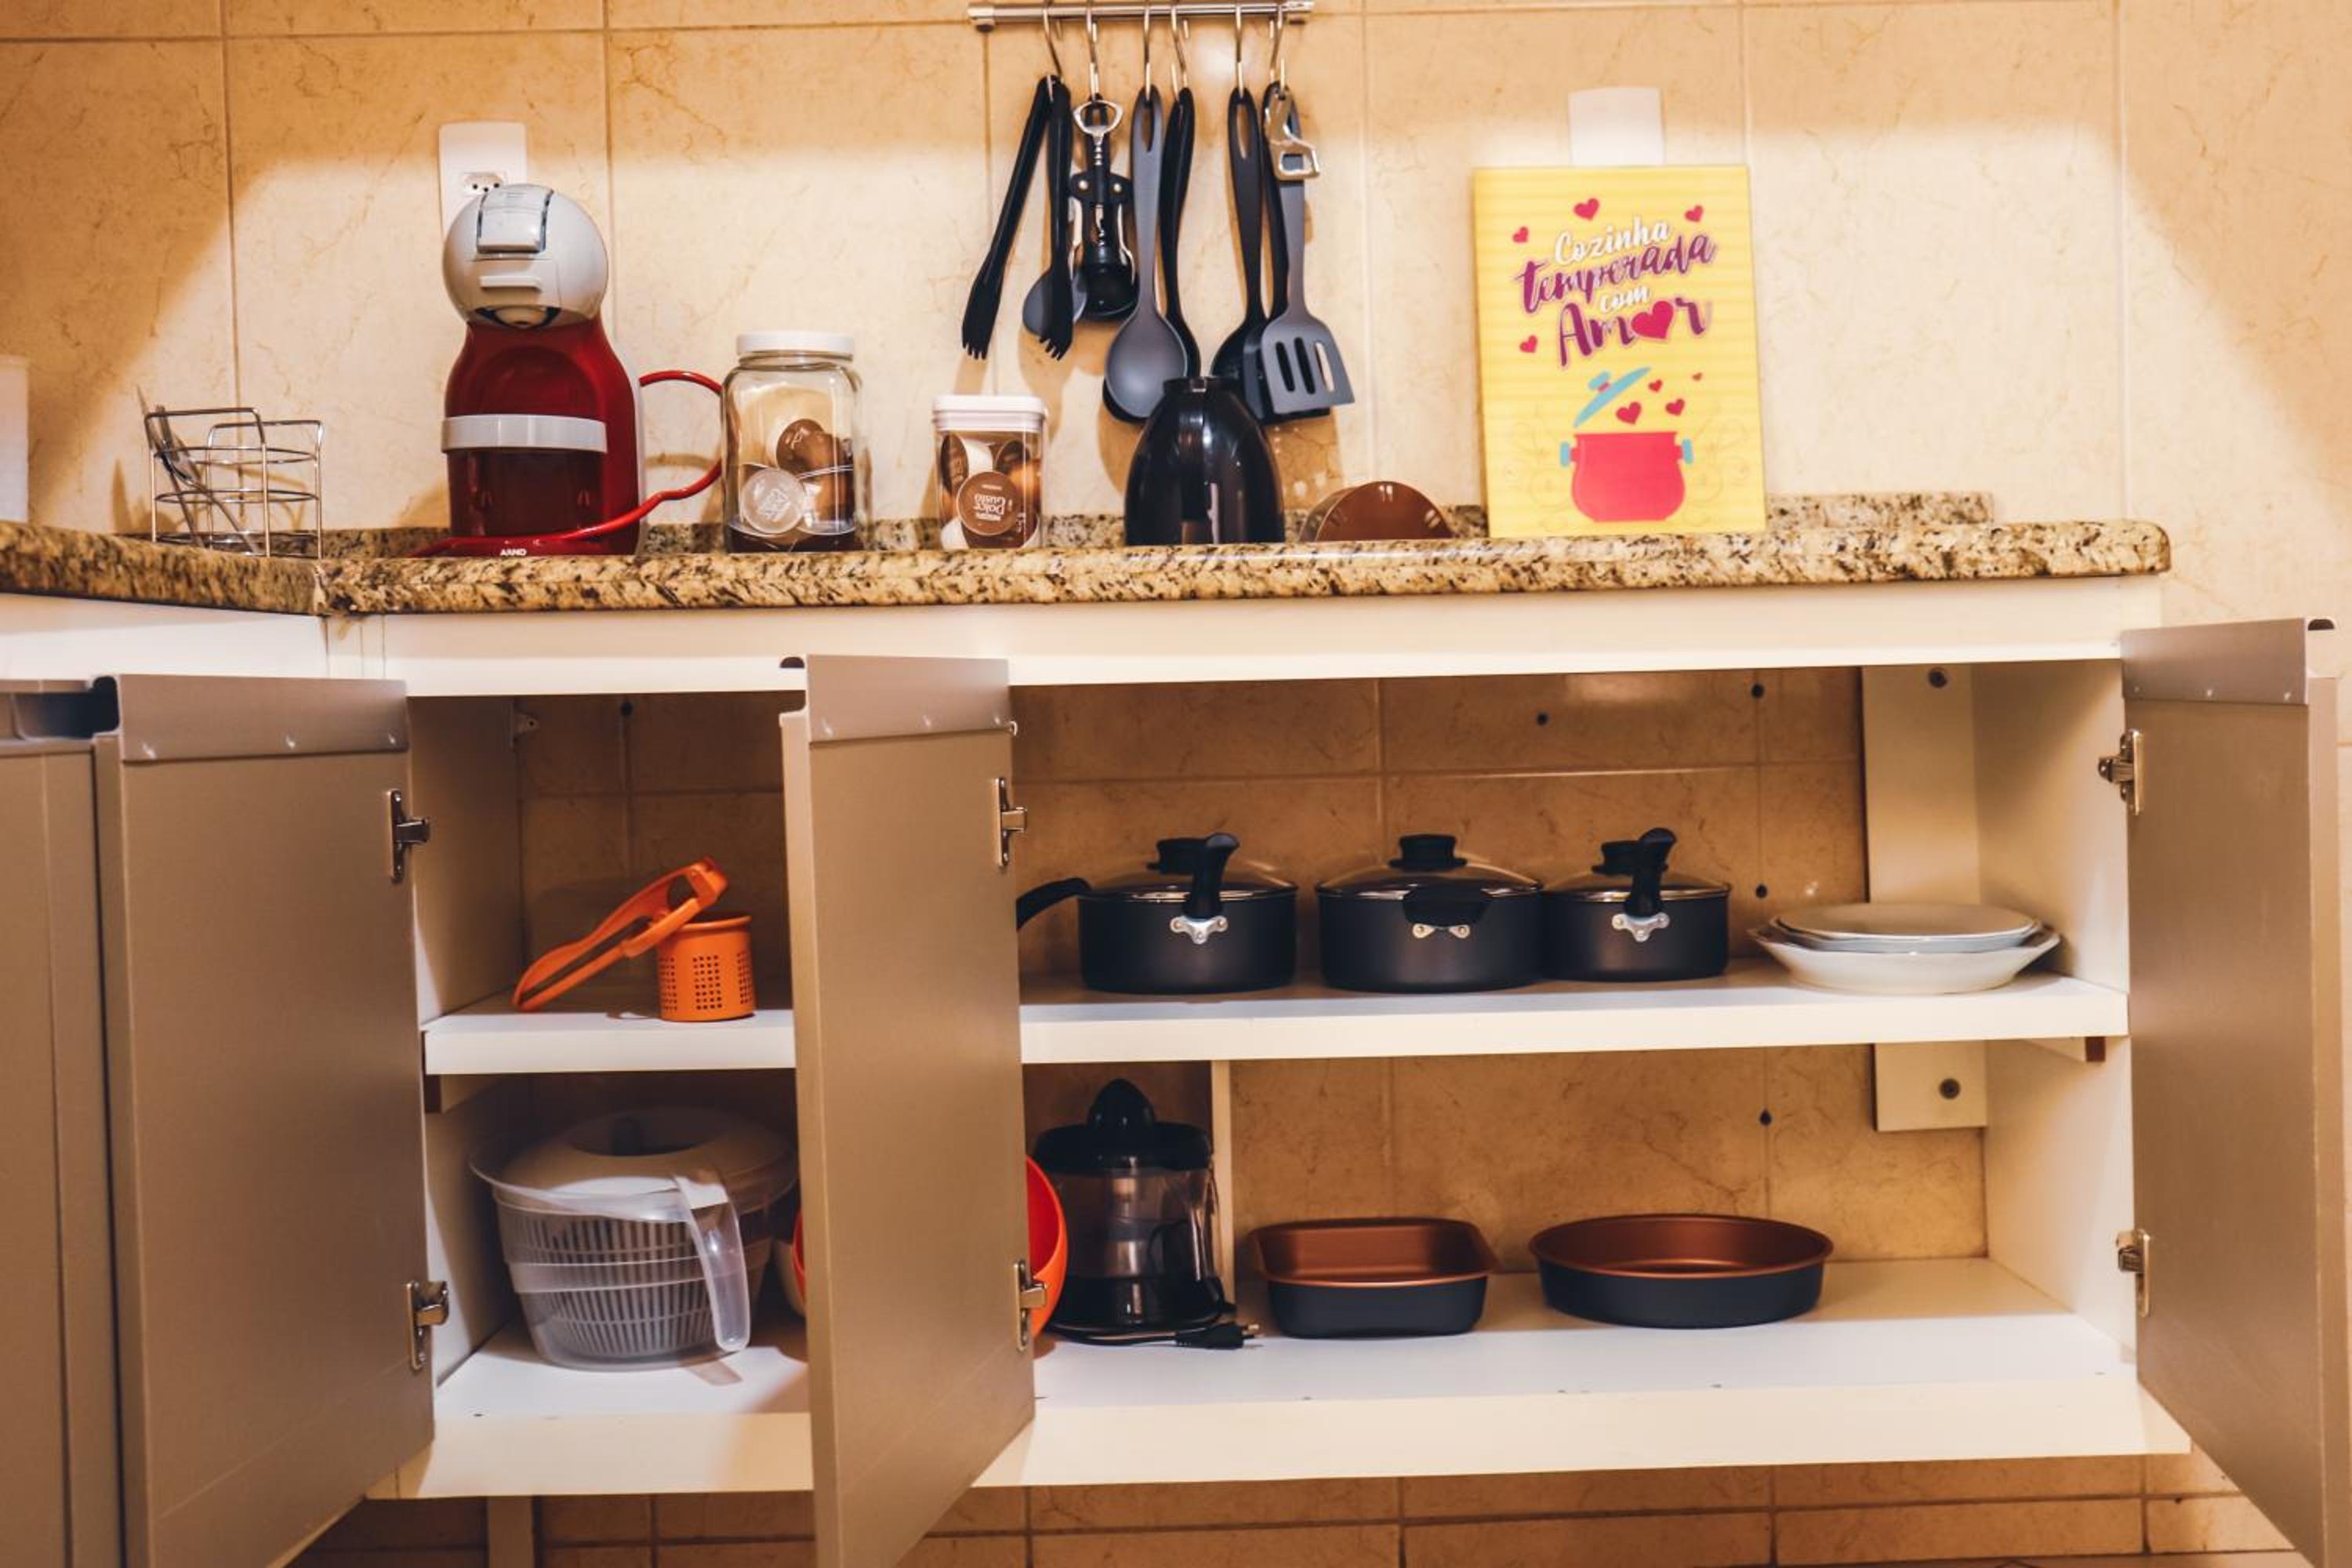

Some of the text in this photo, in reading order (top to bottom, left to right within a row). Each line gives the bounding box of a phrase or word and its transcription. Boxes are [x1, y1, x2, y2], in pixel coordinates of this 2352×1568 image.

[1554, 216, 1670, 265] Cozinha
[1515, 234, 1717, 313] temperada
[1599, 285, 1650, 314] com
